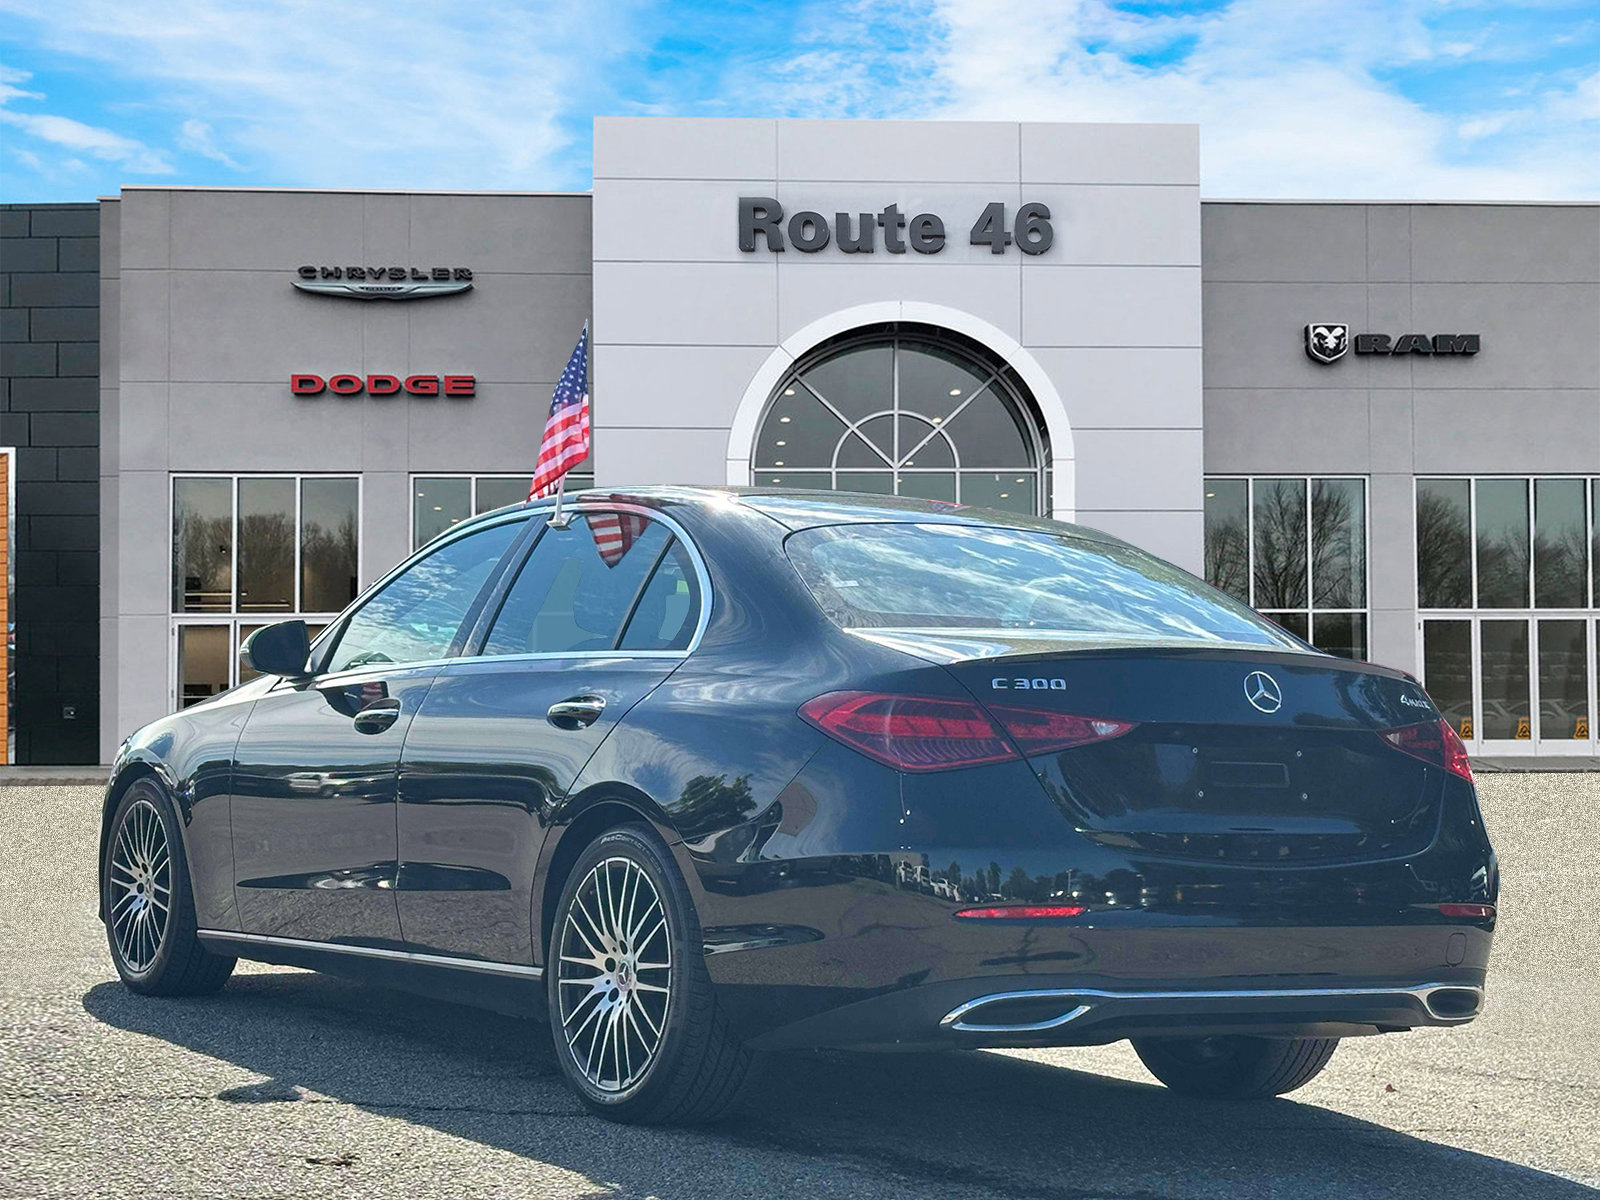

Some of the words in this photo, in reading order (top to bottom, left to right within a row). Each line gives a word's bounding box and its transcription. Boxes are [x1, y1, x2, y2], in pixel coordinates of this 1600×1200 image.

[738, 197, 946, 253] Route
[969, 202, 1054, 255] 46
[298, 266, 473, 281] CHRYSLER
[1355, 334, 1480, 355] RAM
[291, 374, 476, 397] DODGE
[991, 677, 1009, 690] C
[1013, 677, 1067, 691] 300
